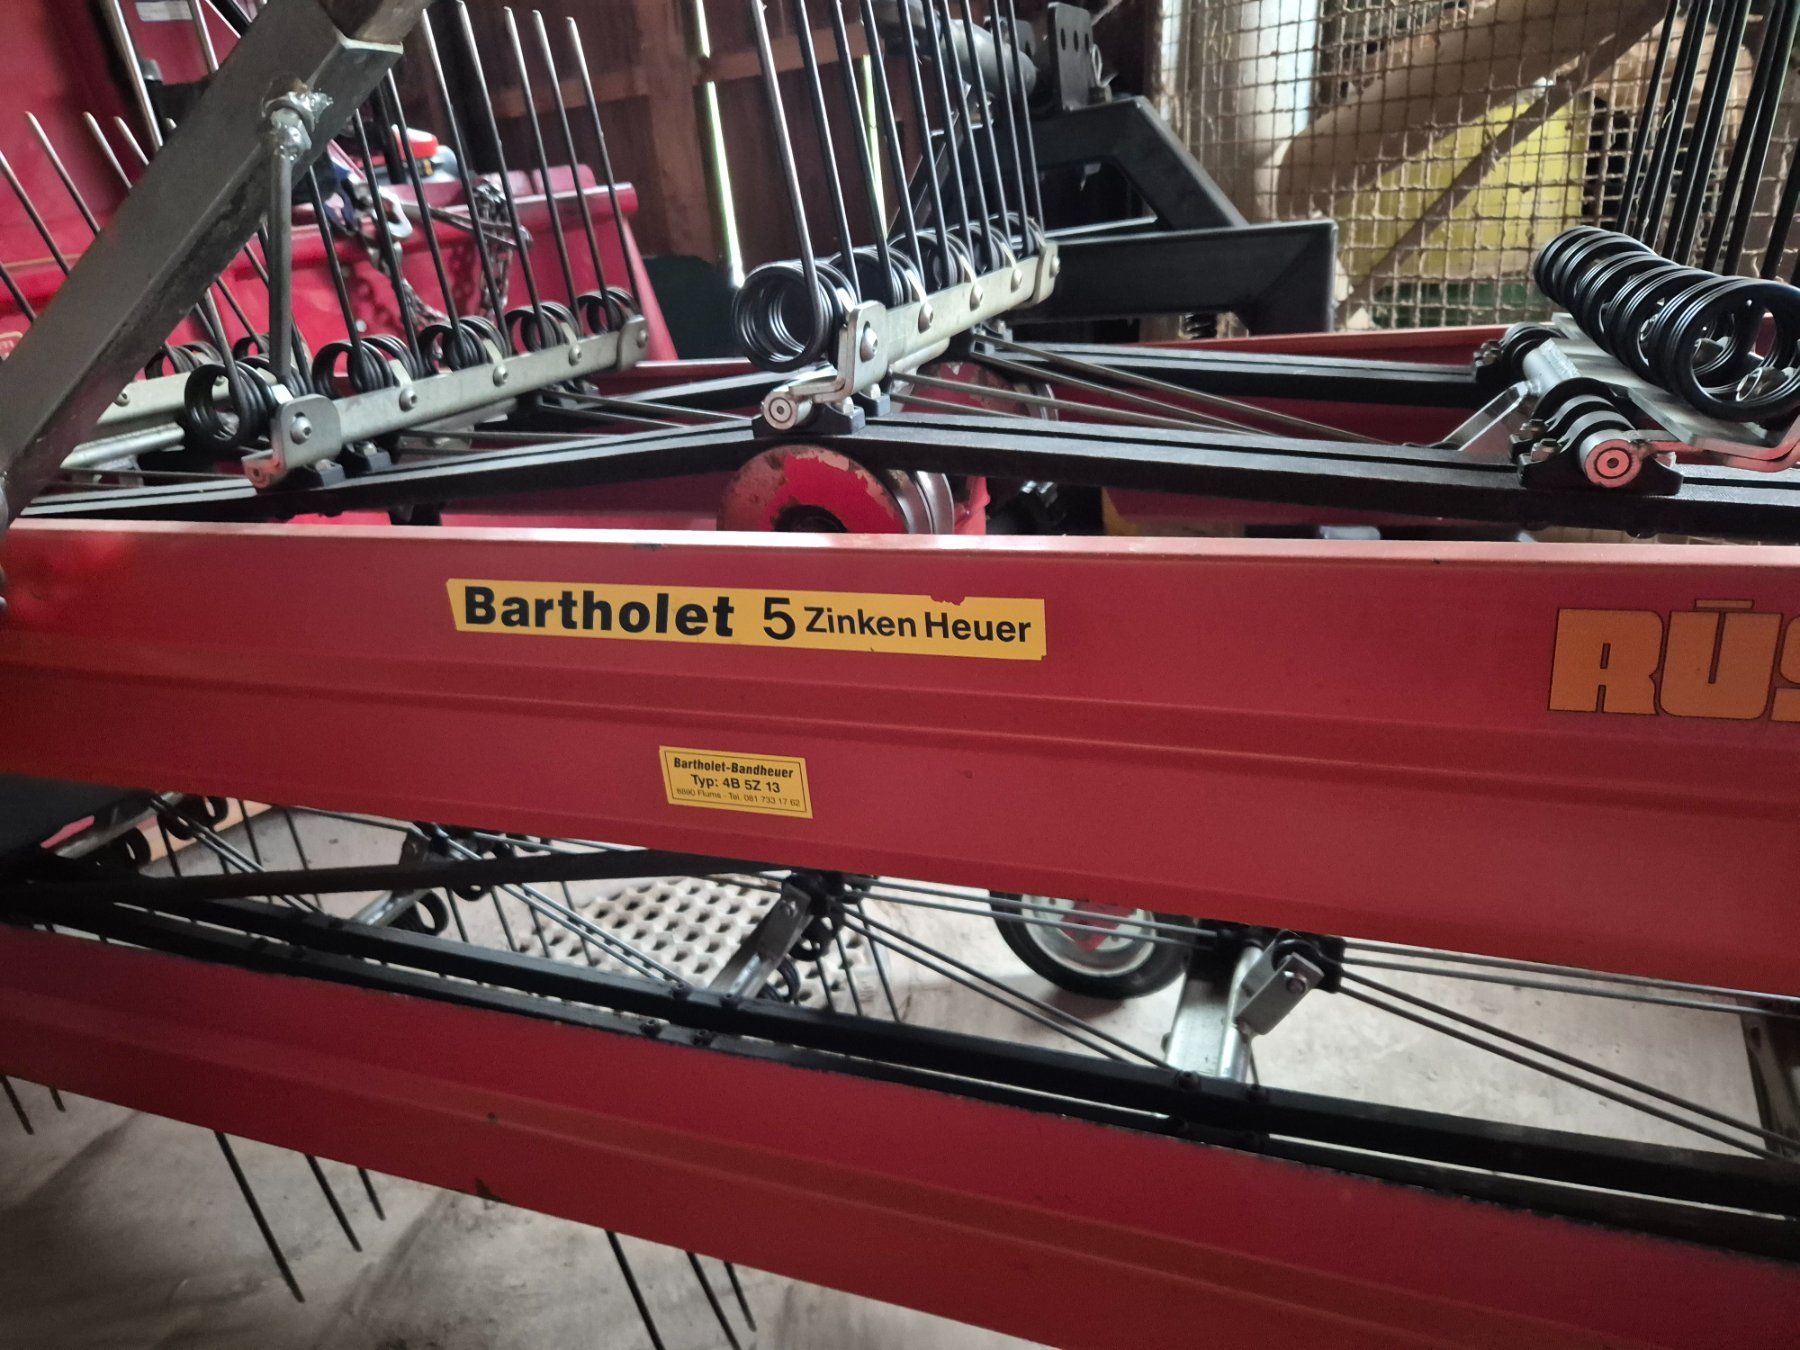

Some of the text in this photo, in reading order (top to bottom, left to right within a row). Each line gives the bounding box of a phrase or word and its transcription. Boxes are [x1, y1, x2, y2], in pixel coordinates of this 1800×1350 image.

[464, 586, 1032, 644] Bartholet 5 Zinken Heuer
[1547, 598, 1800, 722] RÜ
[674, 757, 794, 779] Bartholet-Bandheuer
[691, 774, 781, 794] Typ: 4B 5Z 13
[778, 797, 788, 806] 17
